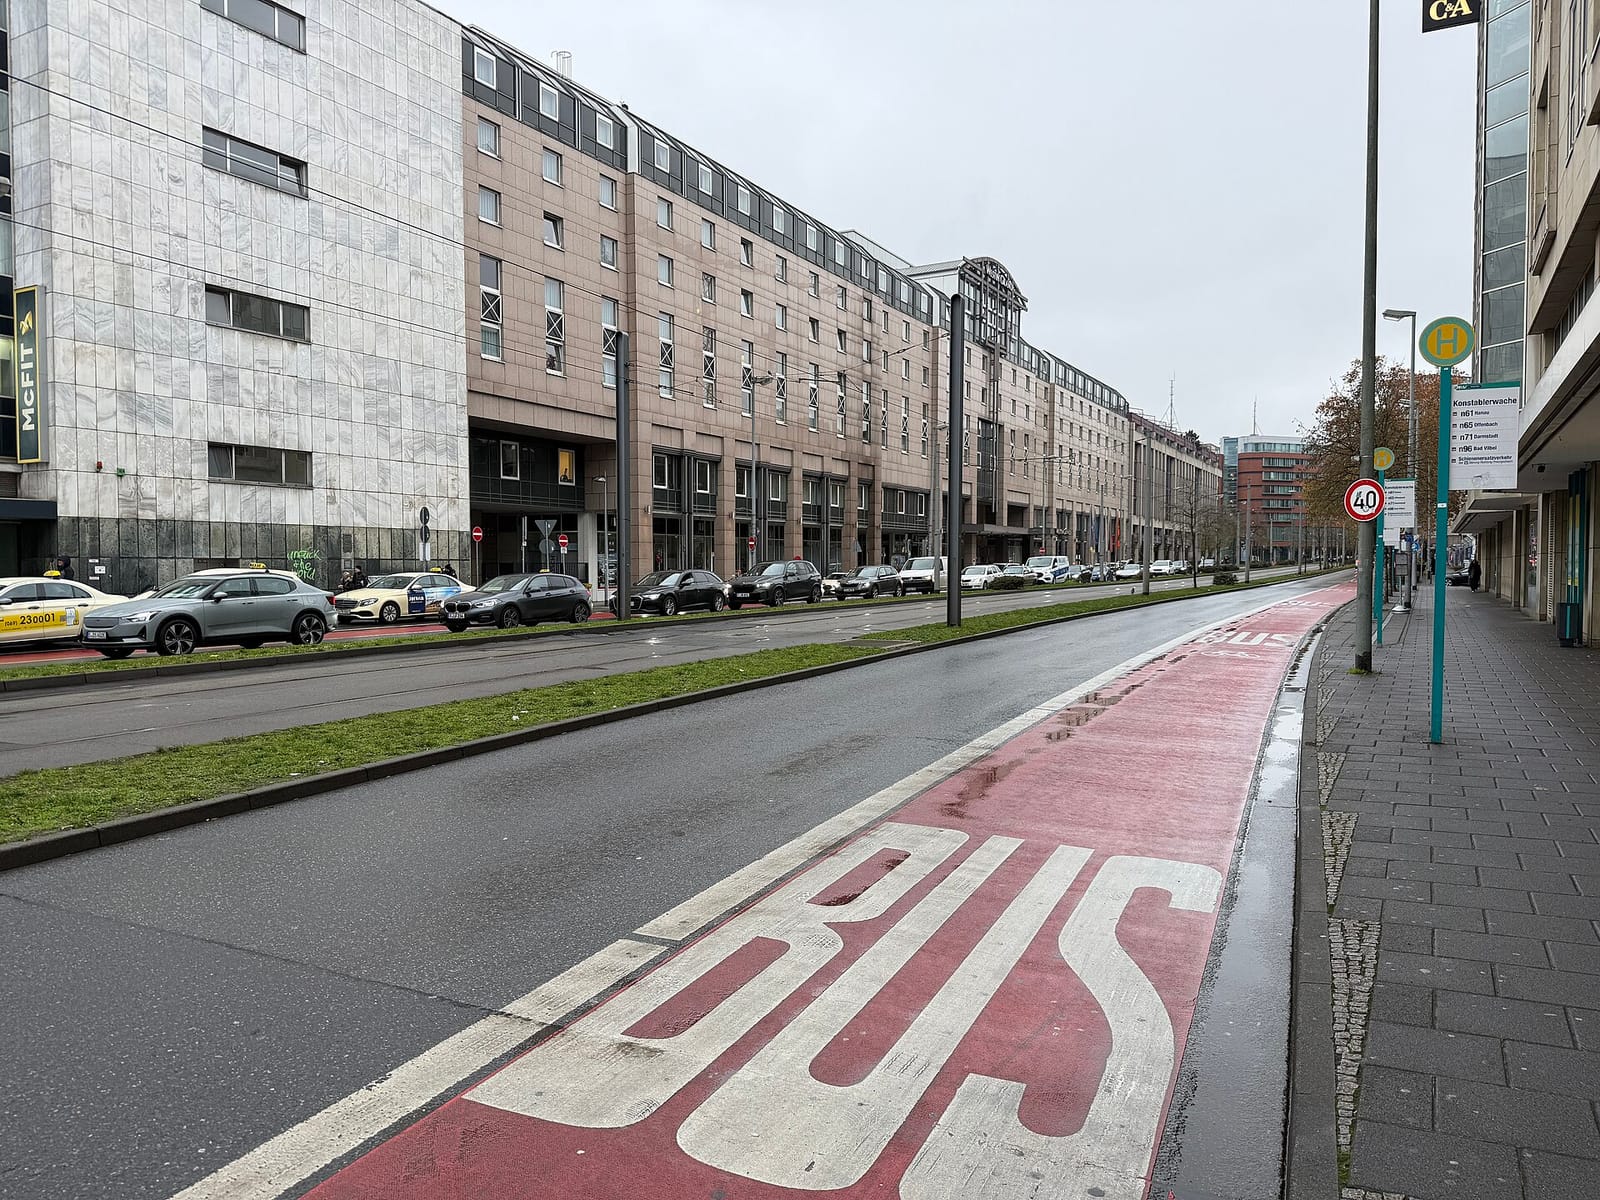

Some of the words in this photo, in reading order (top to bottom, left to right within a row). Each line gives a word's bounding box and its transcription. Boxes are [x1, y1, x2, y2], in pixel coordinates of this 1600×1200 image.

[1436, 327, 1458, 356] H
[1453, 397, 1517, 407] Konstablerwache
[1353, 491, 1376, 509] 40
[20, 613, 55, 625] 230001
[461, 822, 1222, 1200] BUS
